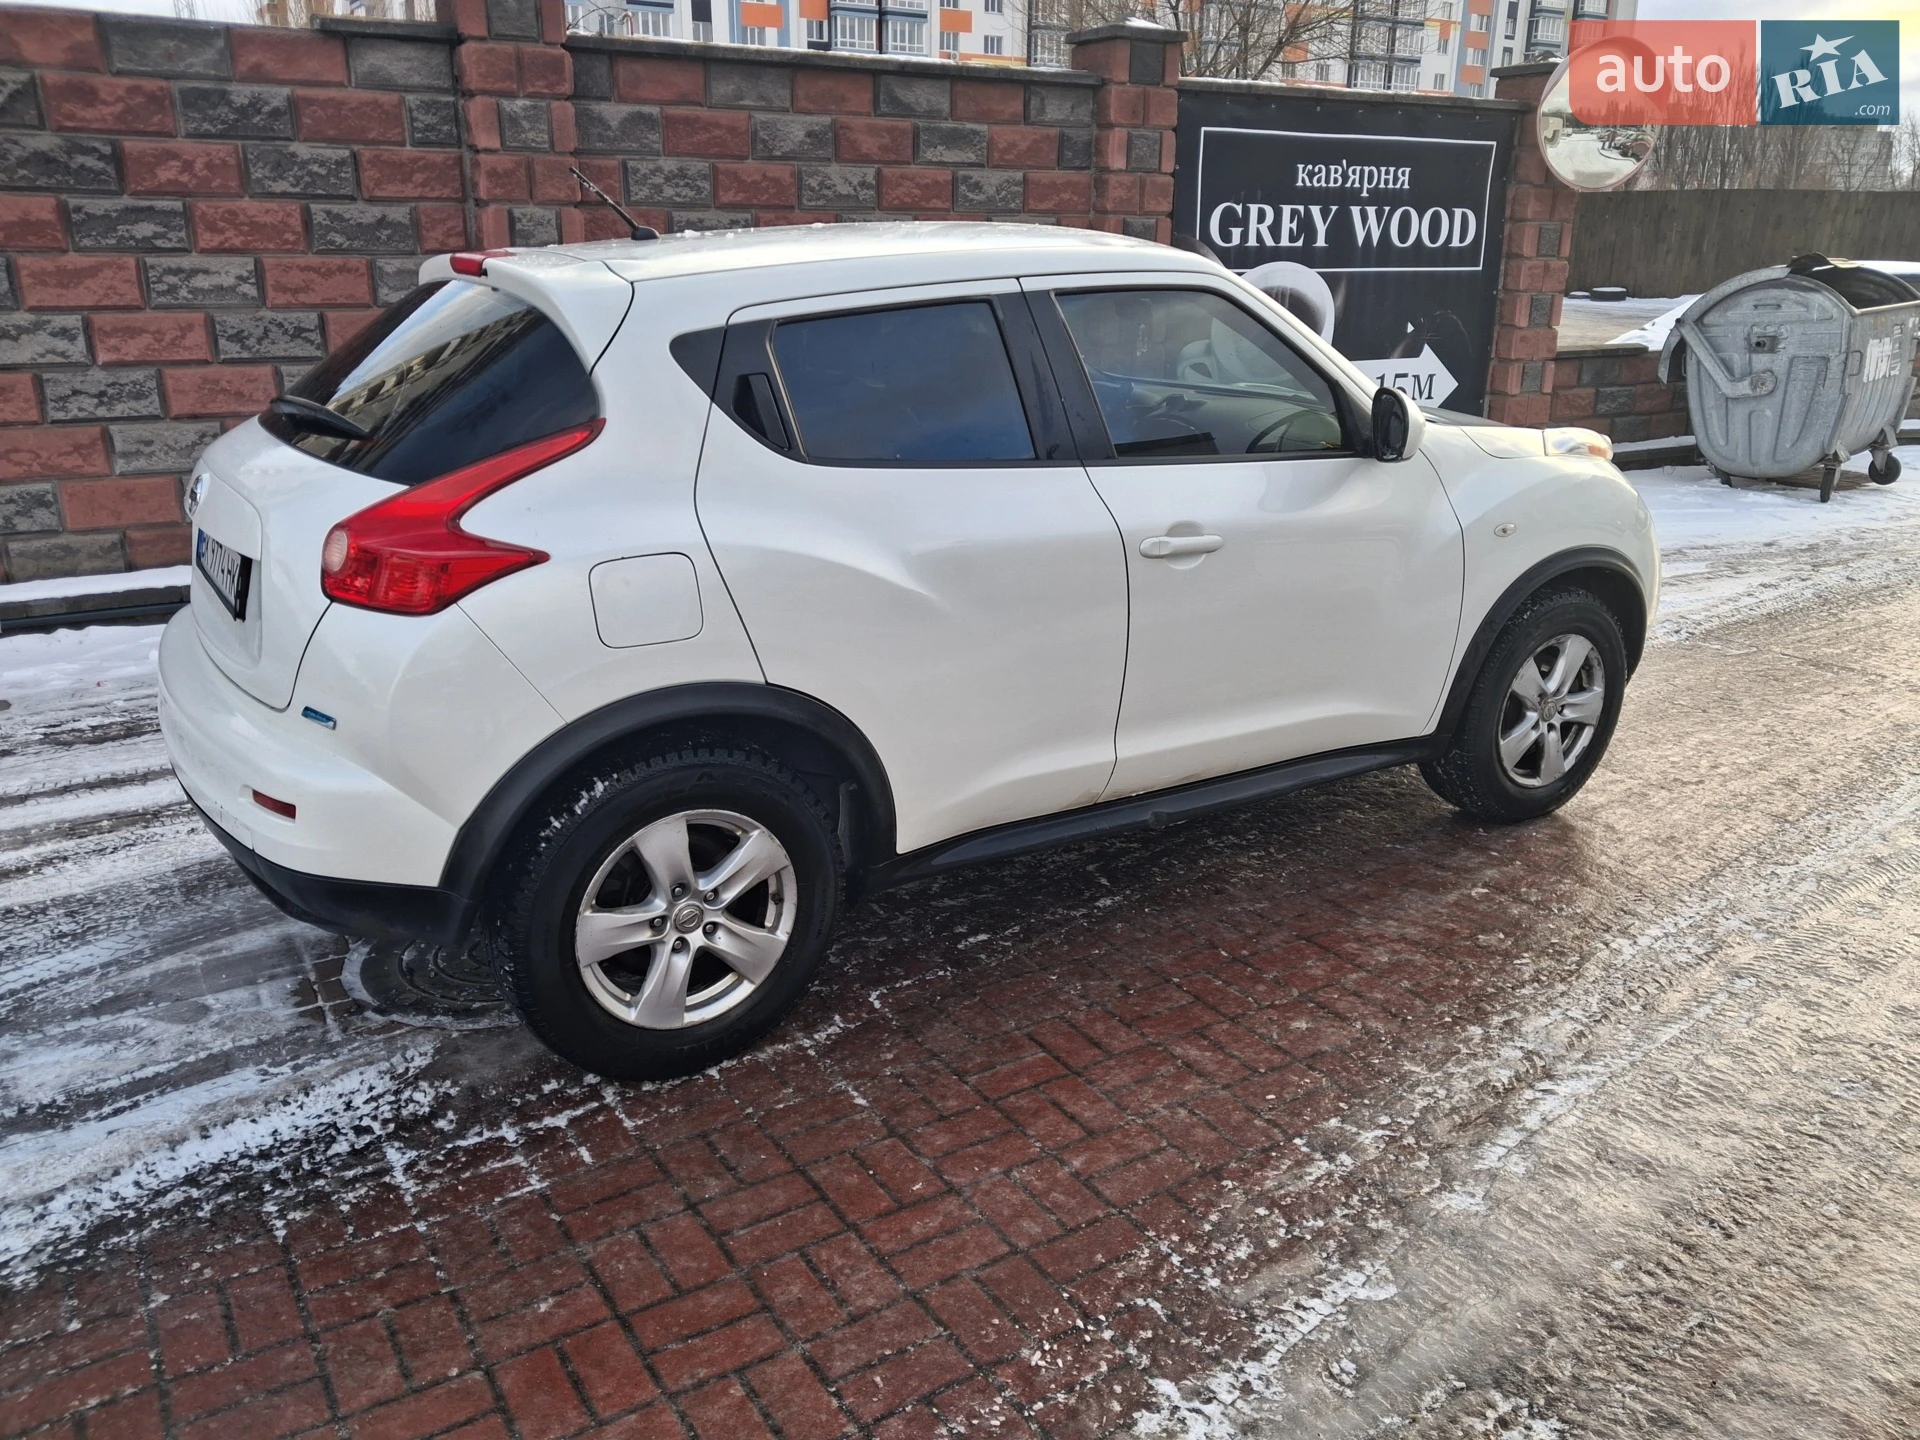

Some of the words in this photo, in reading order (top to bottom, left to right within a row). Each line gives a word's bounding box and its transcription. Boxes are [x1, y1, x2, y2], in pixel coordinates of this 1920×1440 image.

[1296, 159, 1411, 197] кав'ярня
[1209, 202, 1339, 248] GREY
[1349, 204, 1477, 248] WOOD
